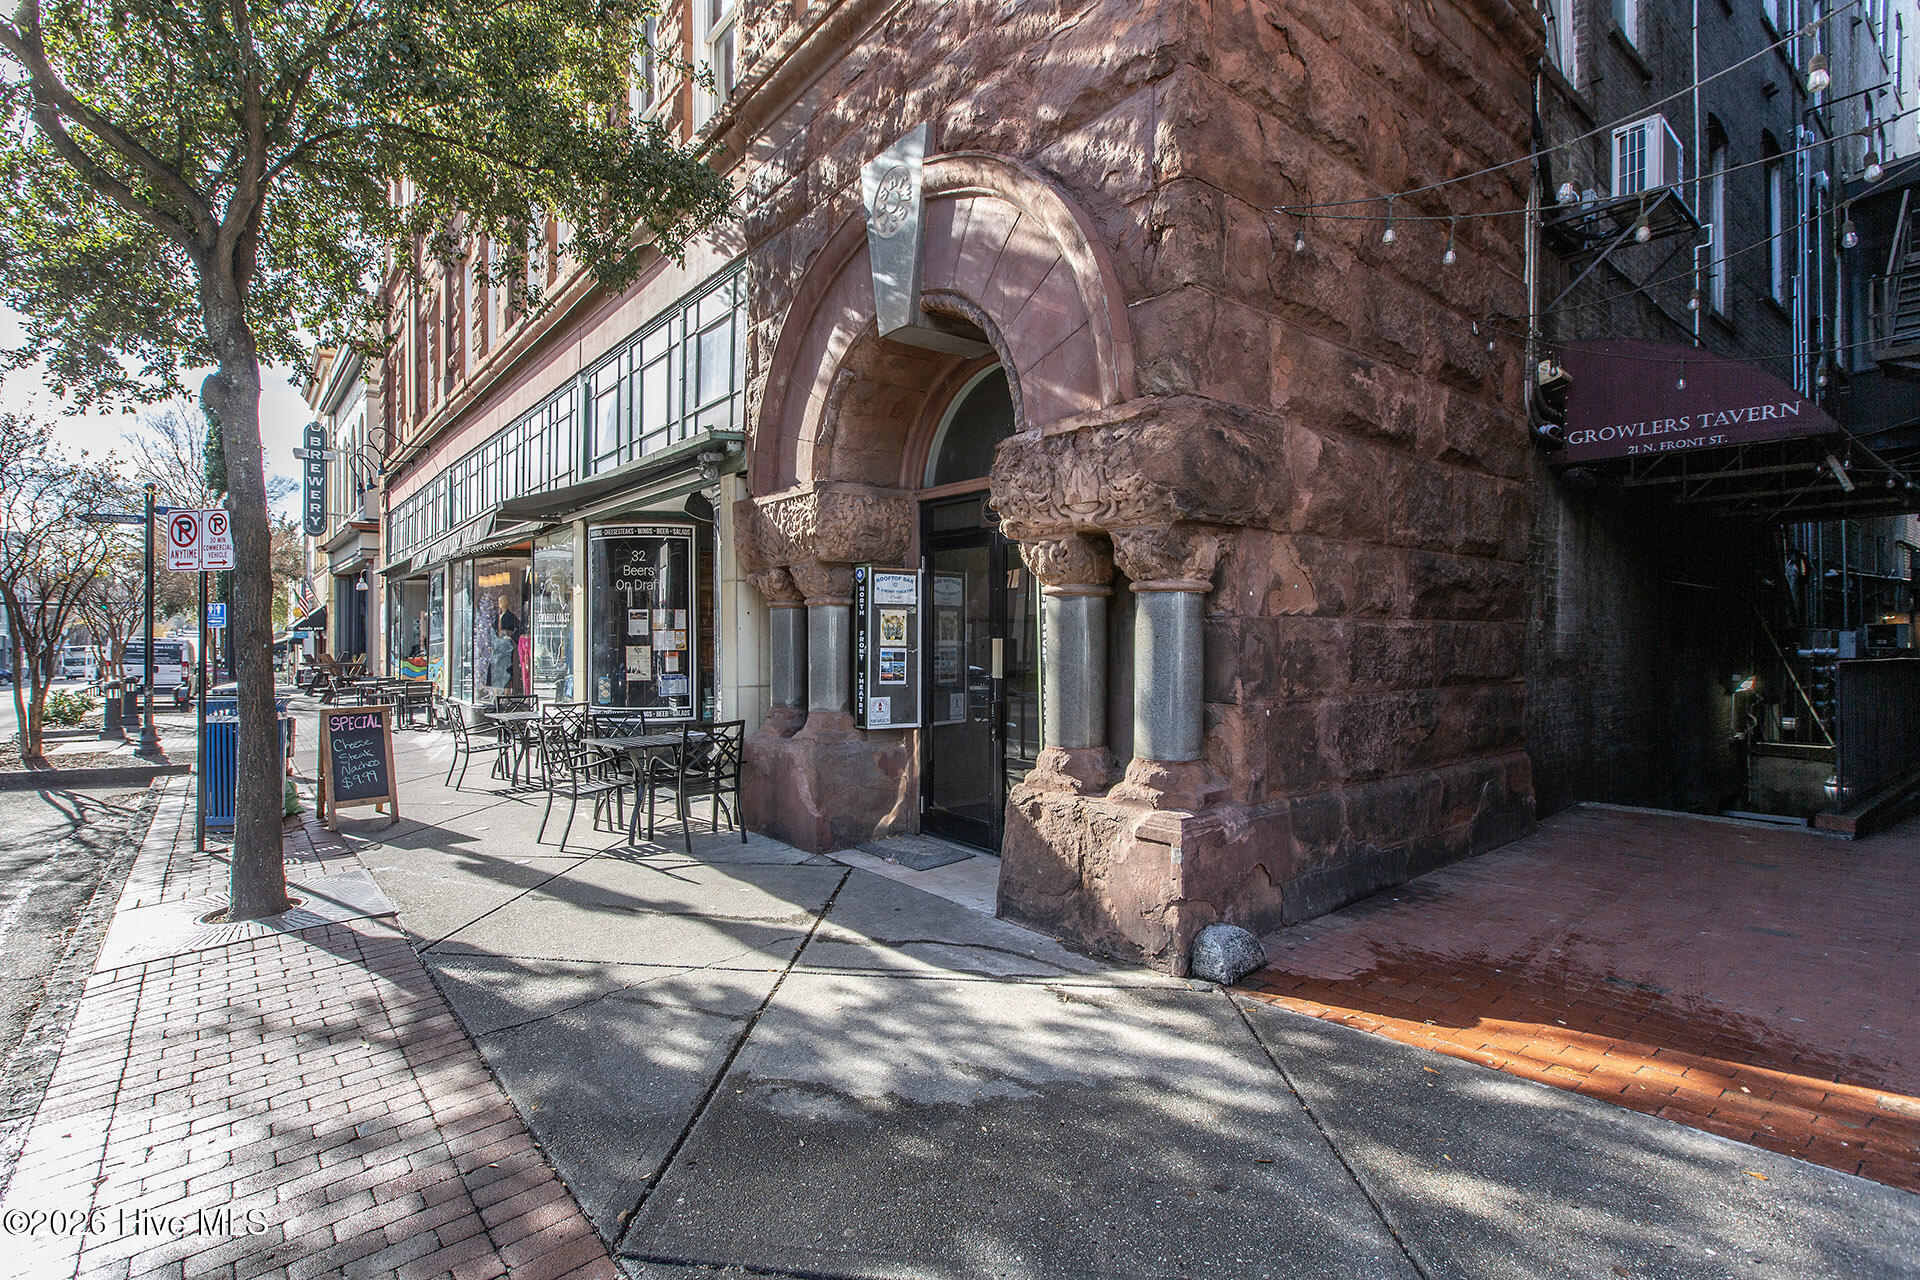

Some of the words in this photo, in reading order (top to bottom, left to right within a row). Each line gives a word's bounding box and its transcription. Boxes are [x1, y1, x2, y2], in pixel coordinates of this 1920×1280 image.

[1568, 415, 1690, 446] GROWLERS
[1697, 400, 1802, 429] TAVERN
[1627, 444, 1642, 455] 21
[1643, 442, 1657, 453] N.
[1659, 436, 1706, 452] FRONT
[1708, 434, 1728, 445] ST.
[307, 436, 324, 526] BREWERY
[672, 528, 691, 536] SALADS
[171, 549, 197, 559] ANYTIME
[208, 551, 227, 559] VEHICLE
[632, 550, 646, 563] 32
[623, 565, 655, 576] Beers
[616, 579, 632, 591] On
[634, 579, 660, 591] Draf
[876, 575, 902, 583] ROOFTOP
[903, 576, 914, 584] BAR
[672, 709, 691, 717] SALADS
[330, 714, 382, 732] SPECIAL
[333, 738, 374, 752] Cheese
[338, 749, 374, 764] Steak
[341, 759, 380, 776] Nachos
[341, 770, 378, 790] $9.99
